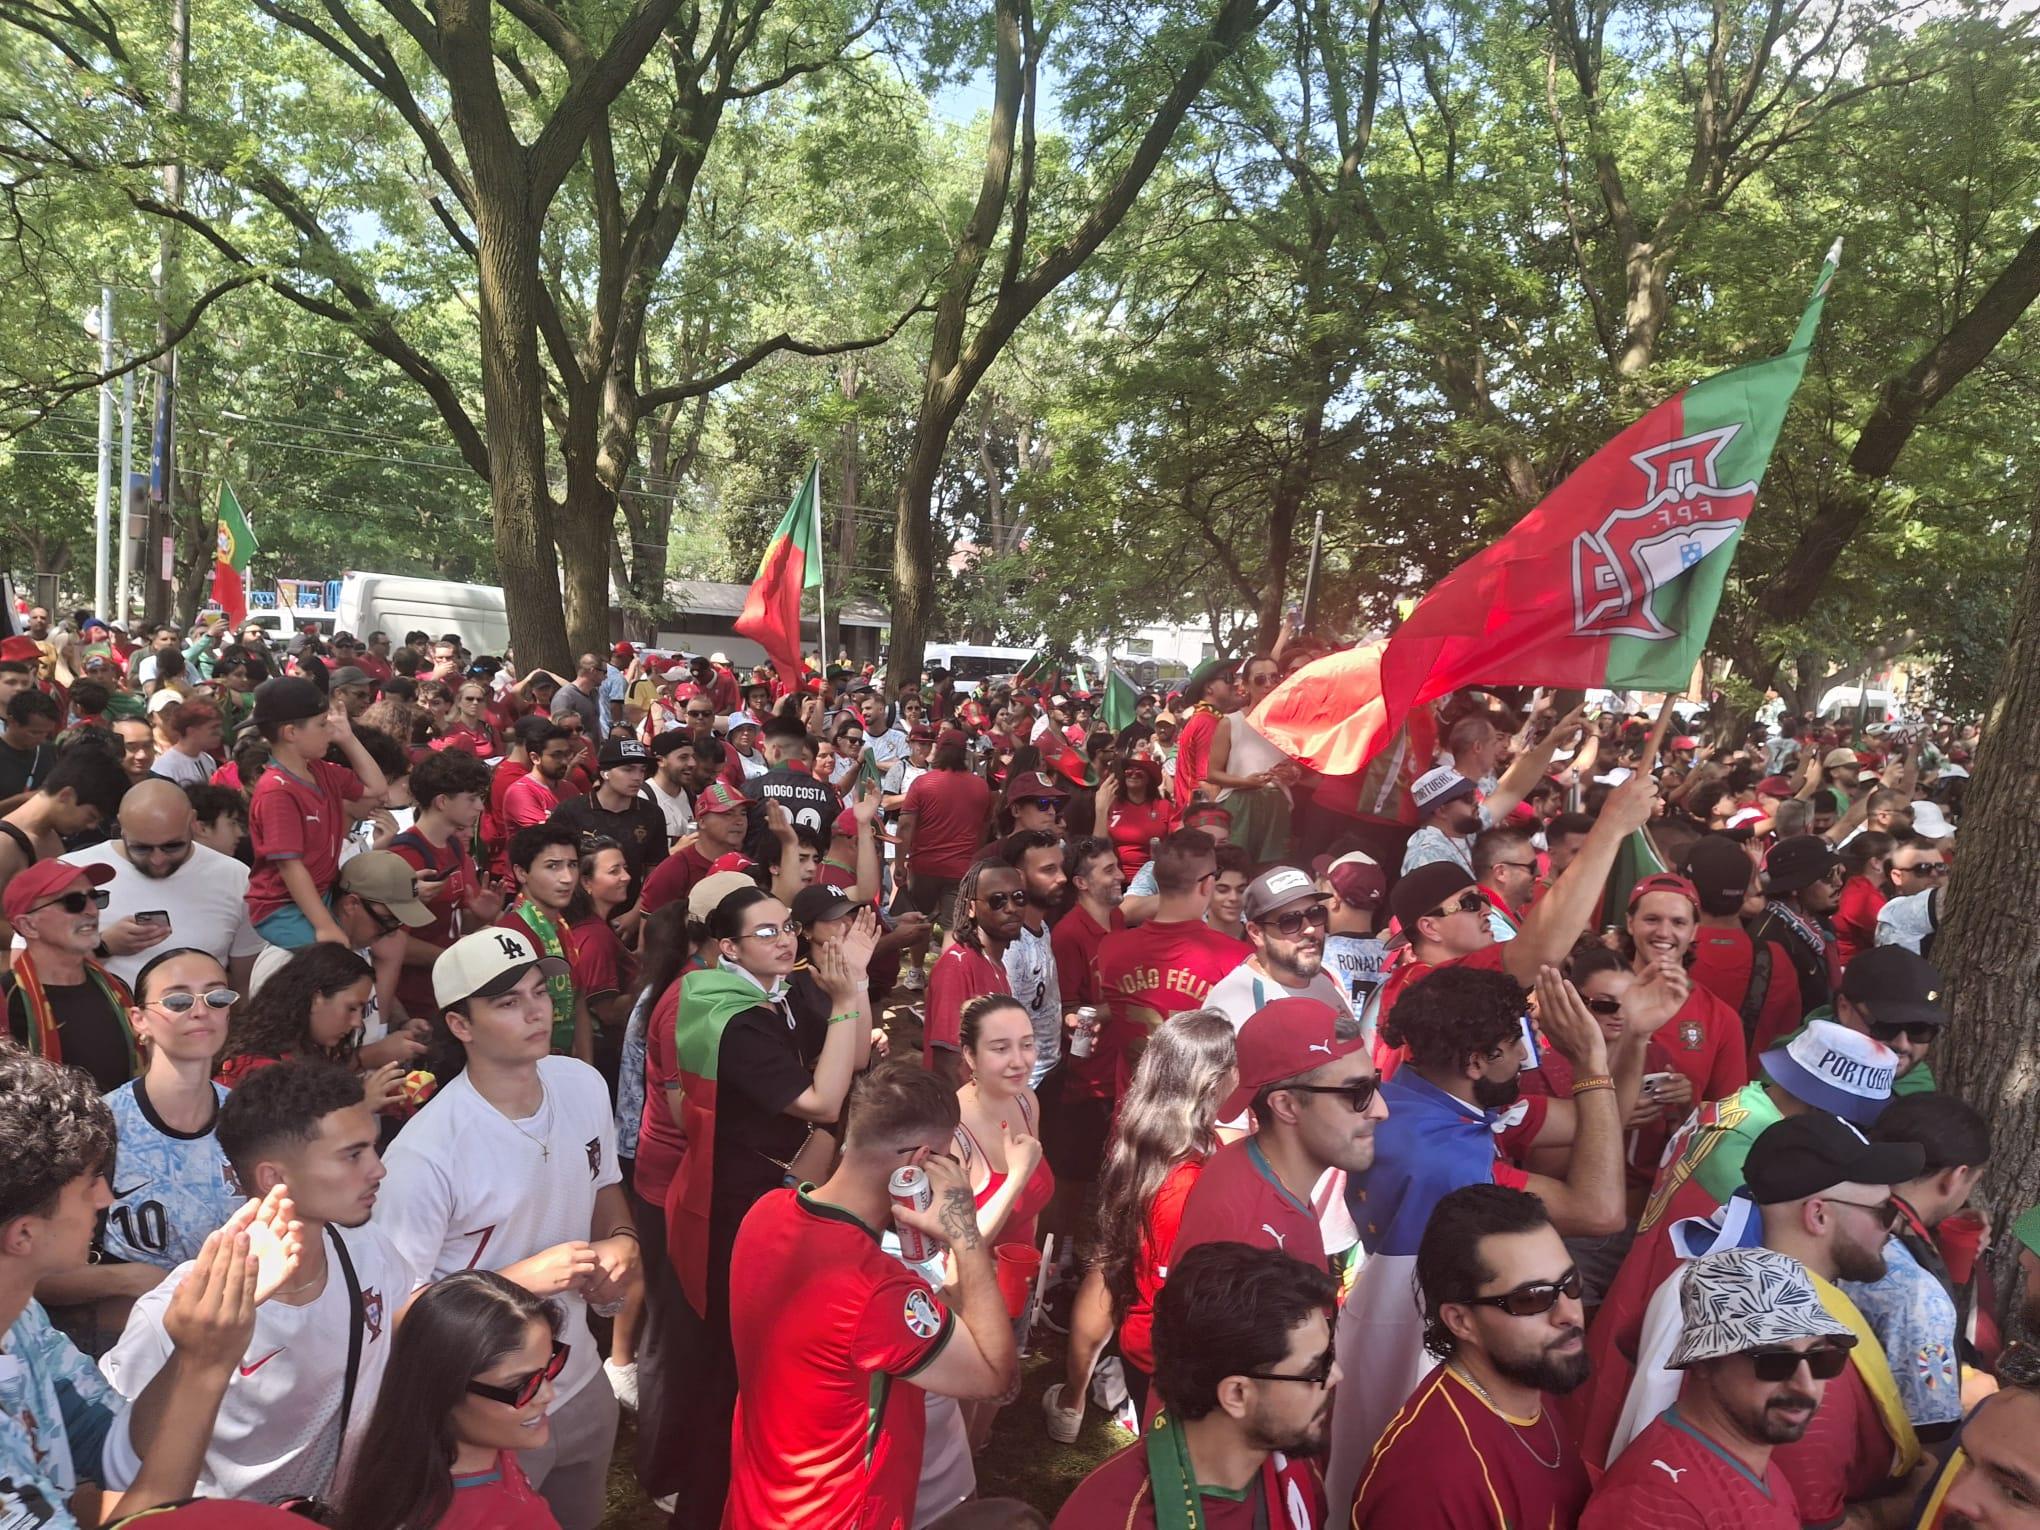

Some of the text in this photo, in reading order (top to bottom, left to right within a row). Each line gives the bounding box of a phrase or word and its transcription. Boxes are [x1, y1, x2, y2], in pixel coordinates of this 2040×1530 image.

[763, 784, 827, 802] DIOGO COSTA
[494, 934, 525, 959] LA
[1337, 954, 1392, 974] RONALD
[111, 1200, 169, 1252] 10
[463, 1224, 497, 1271] 7
